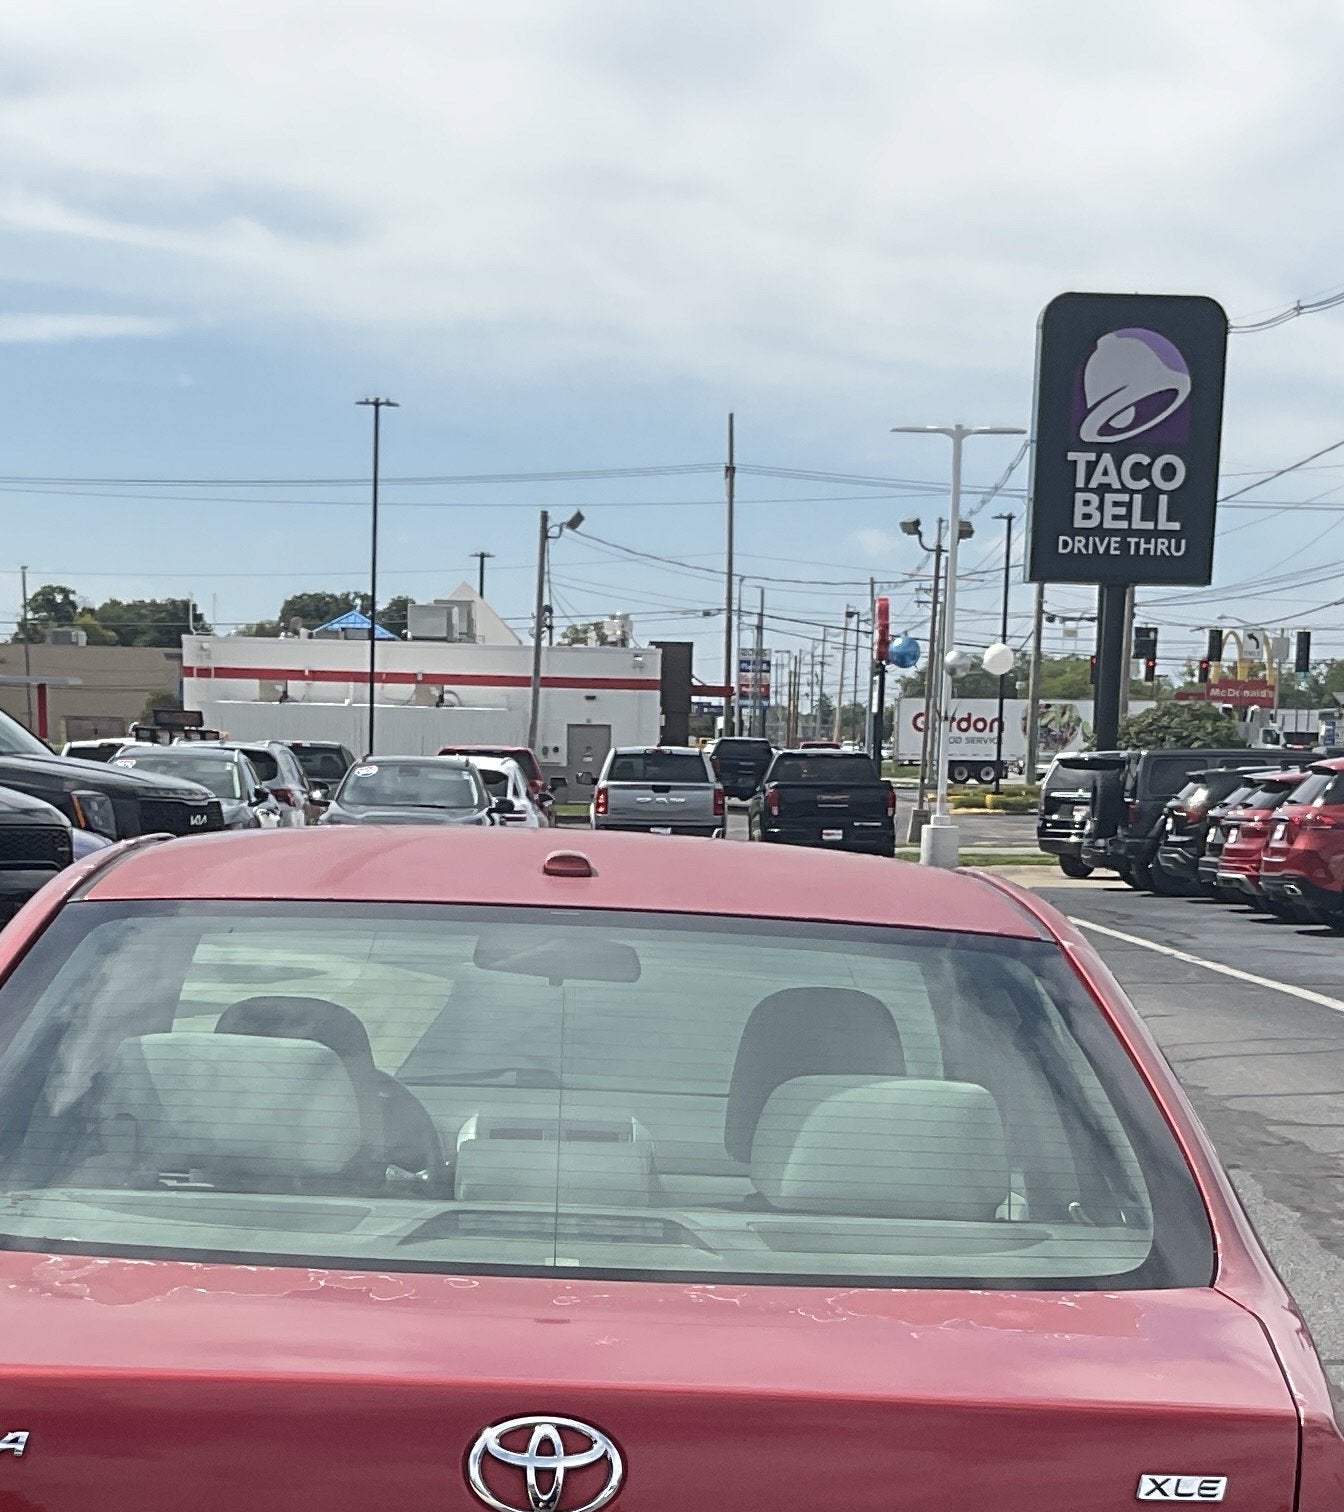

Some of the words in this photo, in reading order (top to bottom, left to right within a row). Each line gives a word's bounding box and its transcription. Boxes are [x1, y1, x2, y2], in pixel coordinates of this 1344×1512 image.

[1067, 451, 1186, 491] TACO
[1073, 491, 1181, 531] BELL
[1057, 535, 1121, 555] DRIVE
[1126, 537, 1186, 557] THRU
[912, 711, 1004, 733] Grdon
[1144, 1477, 1222, 1498] XLE
